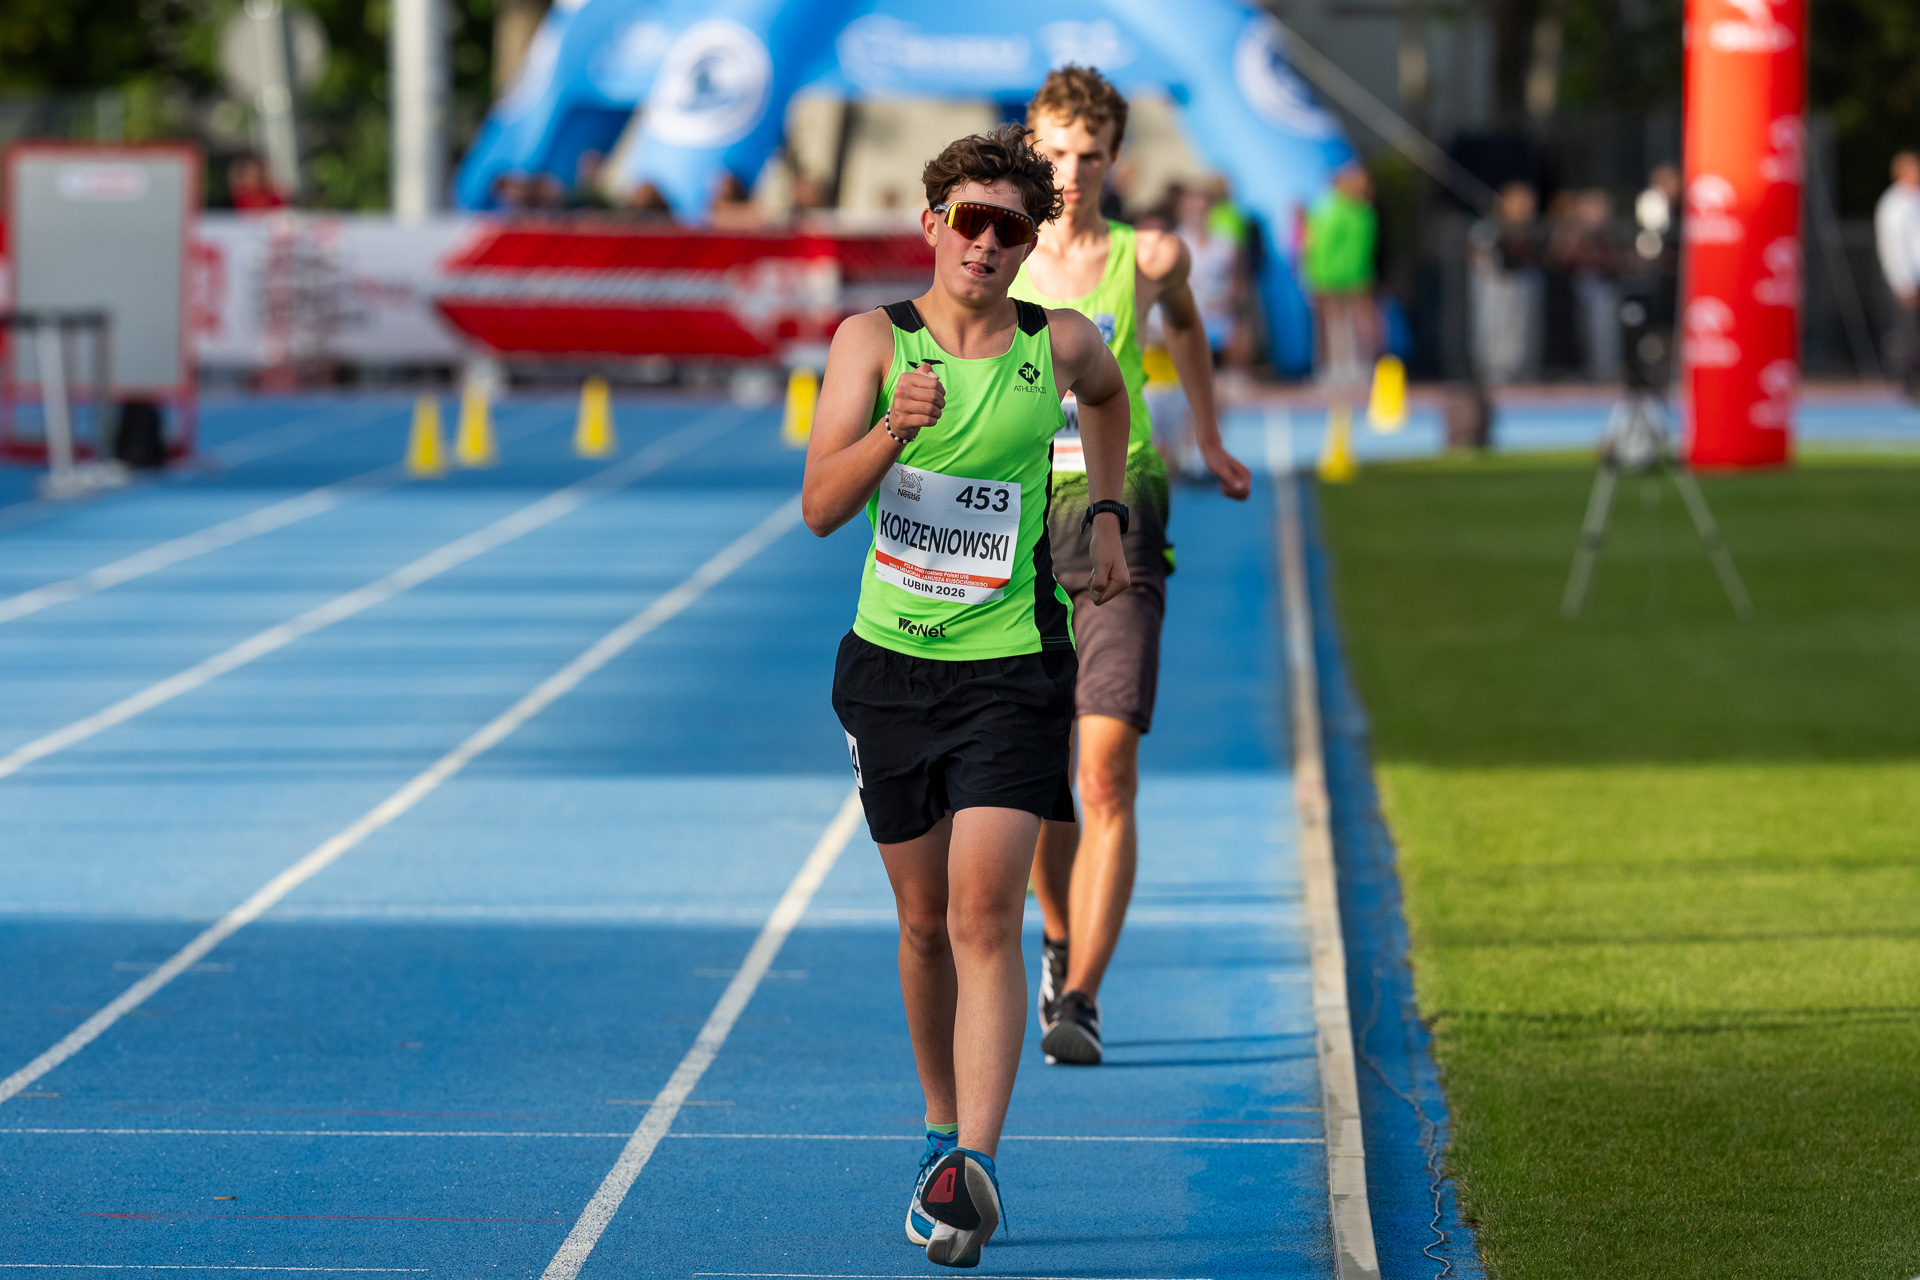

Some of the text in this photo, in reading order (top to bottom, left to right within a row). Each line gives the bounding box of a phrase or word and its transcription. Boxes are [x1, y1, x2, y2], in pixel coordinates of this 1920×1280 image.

[1013, 385, 1047, 395] ATHLETICS
[955, 485, 1010, 513] 453
[879, 509, 1010, 562] KORZENIOWSKI
[921, 574, 945, 583] JANUSZA
[944, 571, 960, 579] Polski
[902, 576, 966, 598] LUBIN 2026
[898, 616, 946, 638] WeNet
